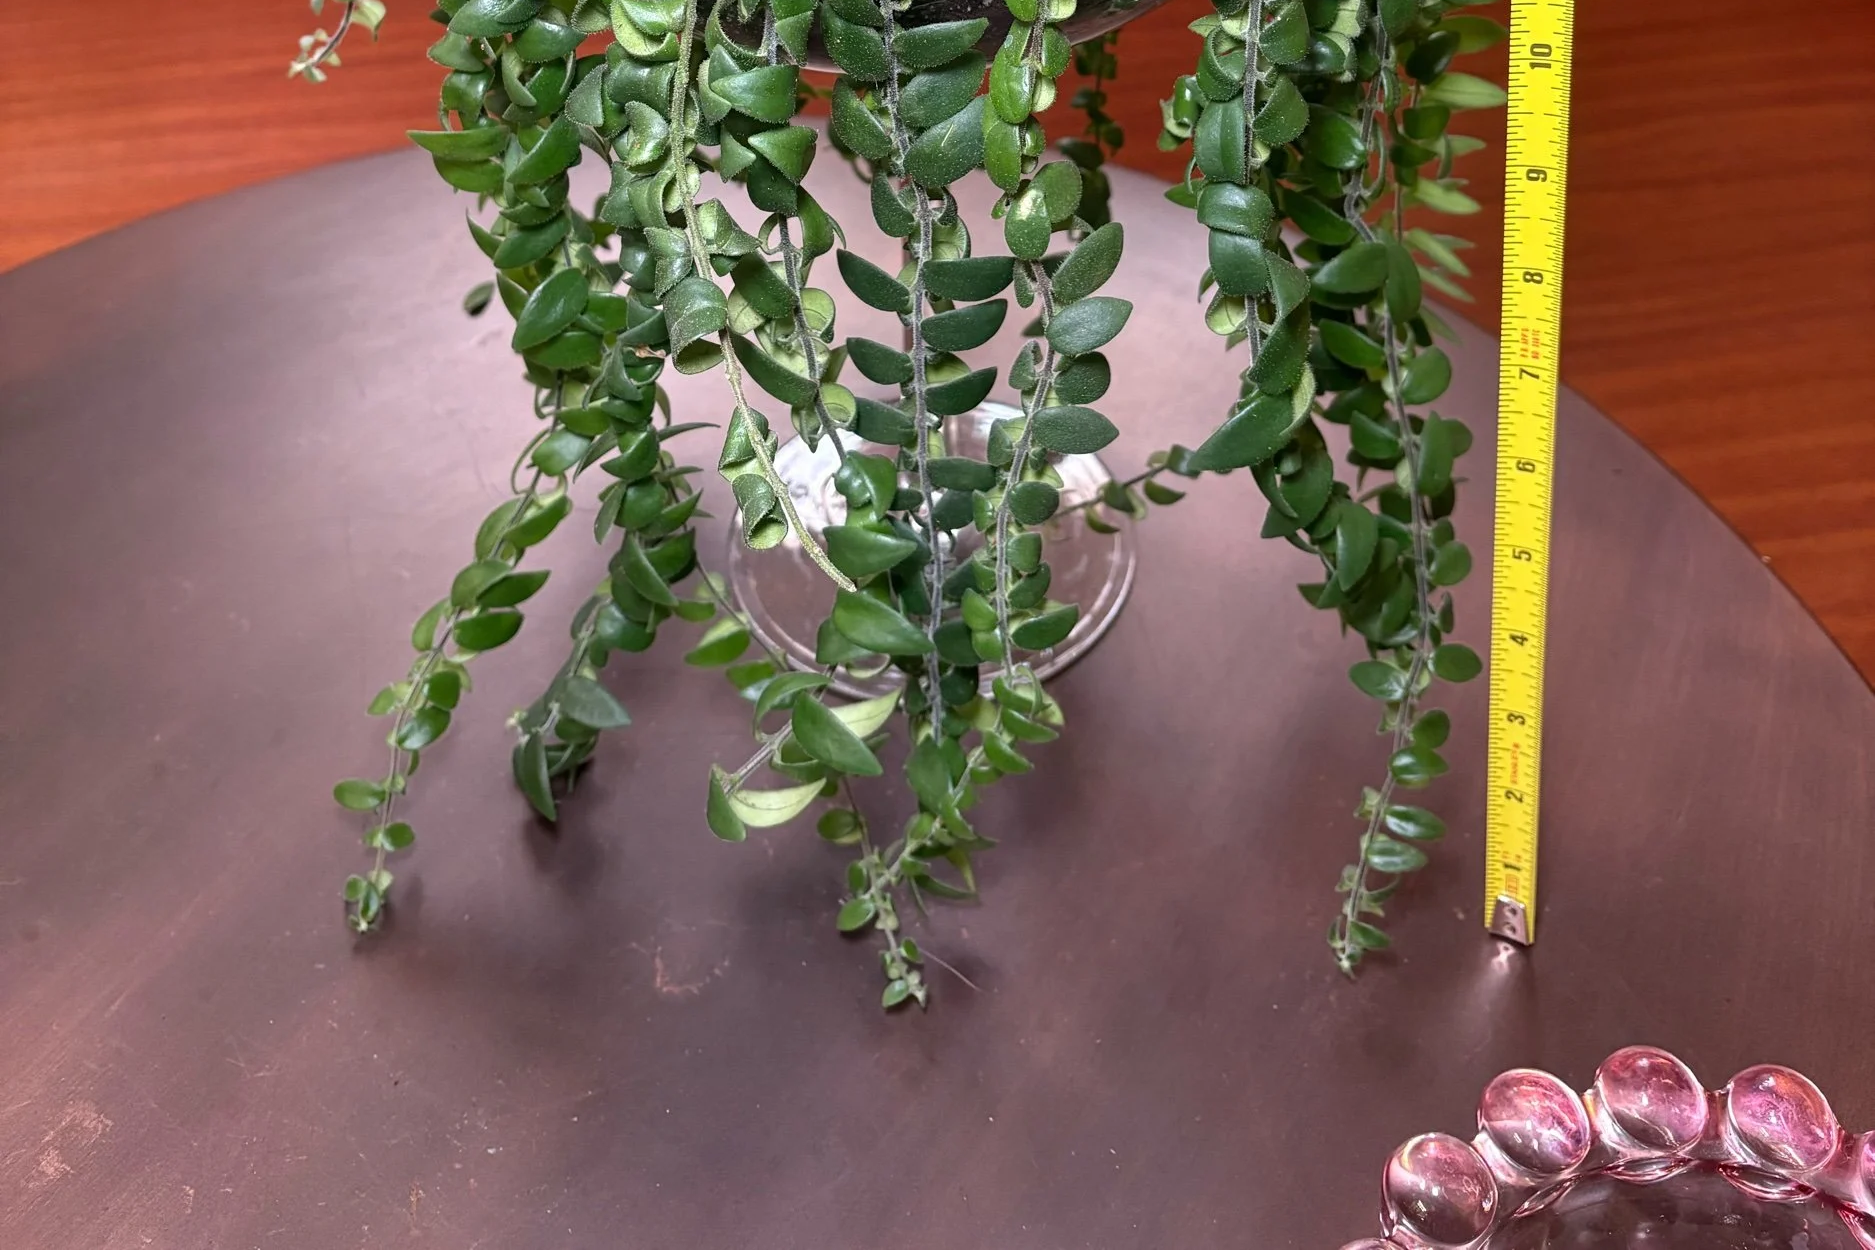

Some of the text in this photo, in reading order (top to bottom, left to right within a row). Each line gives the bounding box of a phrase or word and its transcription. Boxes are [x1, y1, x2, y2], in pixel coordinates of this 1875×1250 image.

[1529, 43, 1552, 70] 10
[1526, 168, 1548, 182] 9
[1523, 271, 1544, 285] 8
[1519, 368, 1540, 380] 7
[1516, 459, 1536, 473] 6
[1512, 548, 1532, 562] 5
[1509, 633, 1529, 647] 4
[1507, 712, 1526, 726] 3
[1504, 790, 1524, 803] 2
[1503, 862, 1523, 872] 1
